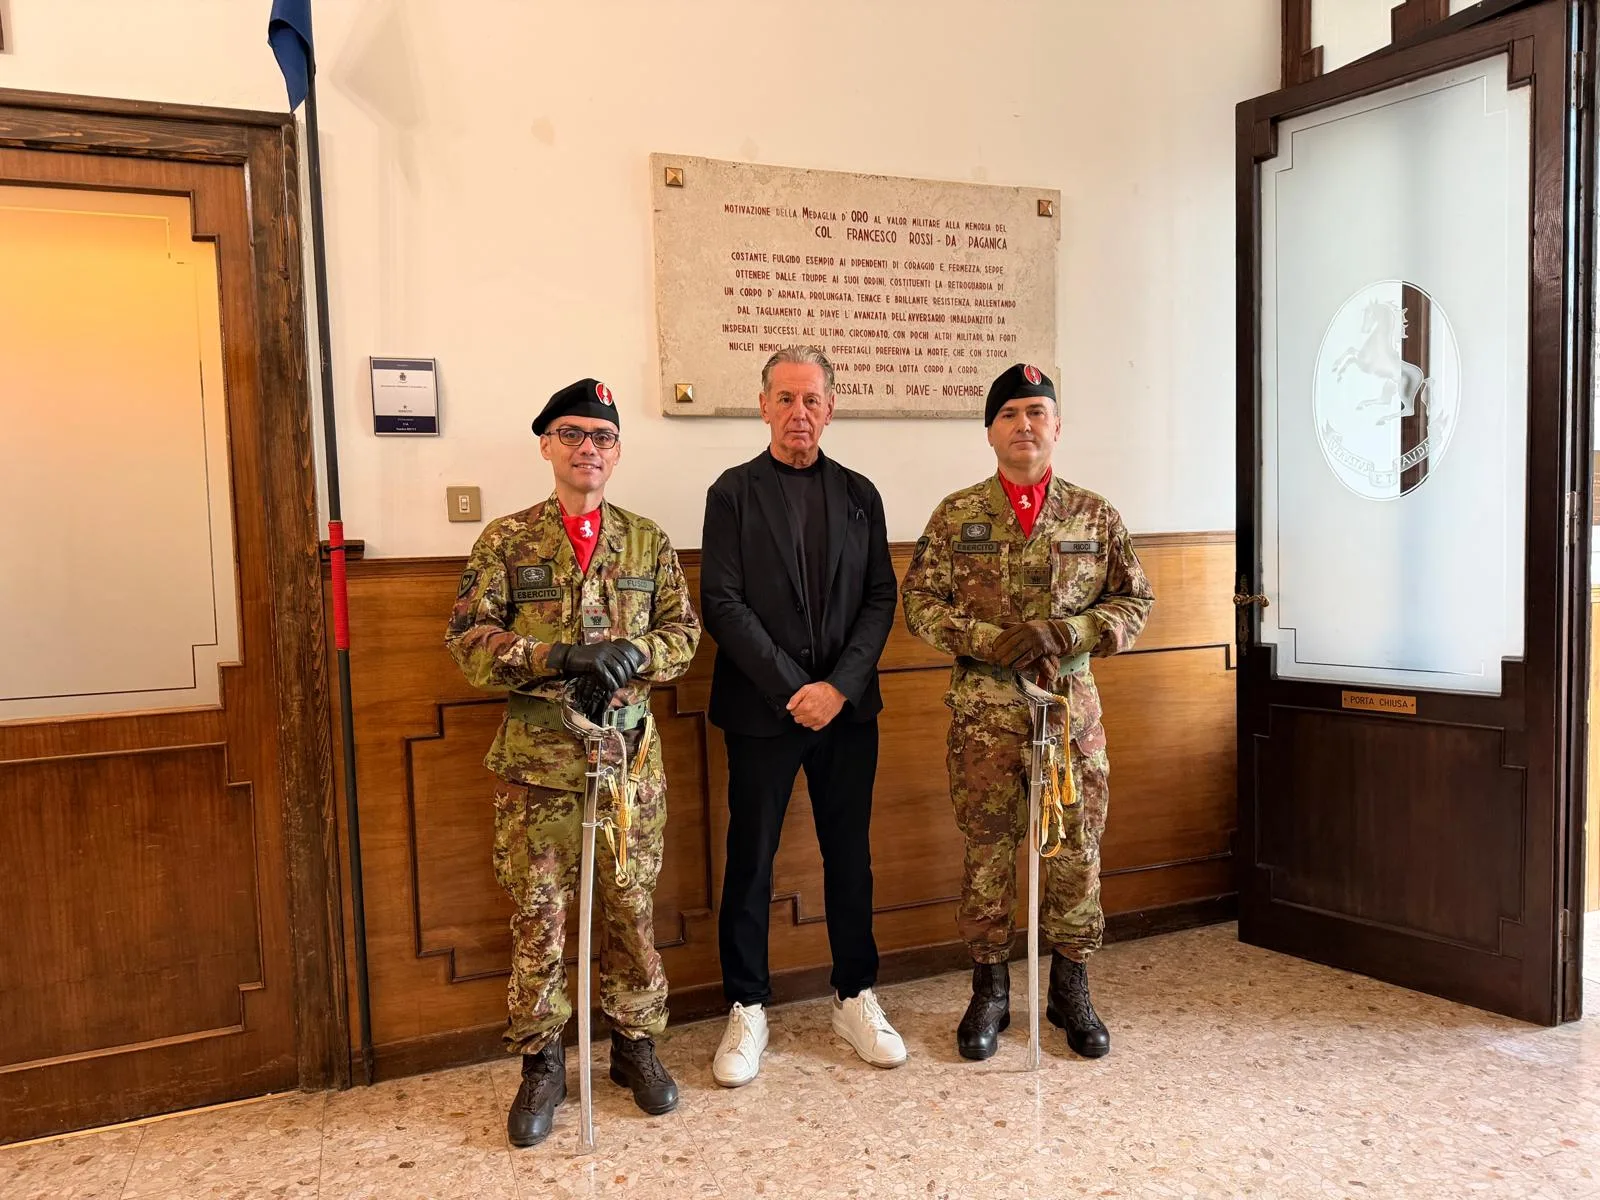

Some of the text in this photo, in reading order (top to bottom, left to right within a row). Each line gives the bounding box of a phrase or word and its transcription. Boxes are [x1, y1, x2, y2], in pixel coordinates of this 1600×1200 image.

[724, 204, 770, 216] MOTIVAZIONE
[776, 208, 797, 218] DELLA
[851, 210, 868, 223] ORO
[874, 215, 881, 224] AL
[887, 216, 907, 226] VALOR
[912, 218, 940, 229] MILITARE
[945, 220, 960, 230] ALLA
[965, 222, 991, 232] MEMORIA
[995, 223, 1007, 233] DEL
[847, 227, 897, 243] FRANCESCO
[909, 231, 933, 246] ROSSI
[945, 234, 957, 248] DA
[968, 235, 1008, 251] PAGANICA
[772, 253, 801, 264] FULGIDO
[805, 255, 835, 267] ESEMPIO
[839, 258, 846, 266] AI
[851, 258, 888, 269] DIPENDENTI
[892, 260, 899, 269] DI
[904, 261, 935, 271] CORAGGIO
[984, 265, 1004, 275] SEPPE
[735, 269, 771, 280] OTTENERE
[775, 271, 797, 282] DALLE
[802, 273, 827, 284] TRUPPE
[832, 275, 839, 284] AI
[843, 276, 859, 285] SUOI
[889, 278, 931, 288] COSTITUENTI
[935, 280, 943, 289] LA
[947, 281, 993, 291] RETROGUARDIA
[997, 283, 1004, 291] DI
[724, 286, 734, 296] UN
[739, 287, 762, 297] CORPO
[857, 293, 881, 303] TENACE
[885, 295, 890, 304] E
[894, 295, 928, 305] BRILLANTE
[974, 299, 1017, 309] RALLENTANDO
[737, 305, 751, 315] DAL
[756, 306, 802, 317] TAGLIAMENTO
[807, 308, 815, 318] AL
[820, 309, 840, 319] PIAVE
[853, 311, 887, 321] AVANZATA
[950, 314, 993, 325] IMBALDANZITO
[997, 315, 1006, 325] DA
[722, 323, 758, 335] INSPERATI
[892, 330, 906, 339] CON
[910, 330, 929, 340] POCHI
[934, 331, 952, 341] ALTRI
[986, 334, 995, 342] DA
[999, 334, 1017, 343] FORTI
[728, 342, 754, 352] NUCLEI
[831, 345, 871, 355] OFFERTAGLI
[875, 346, 911, 356] PREFERIVA
[914, 347, 923, 357] LA
[952, 348, 965, 358] CHE
[969, 349, 982, 358] CON
[986, 349, 1008, 359] STOICA
[831, 362, 850, 372] TAVA
[853, 363, 871, 372] DOPO
[875, 363, 895, 373] EPICA
[899, 364, 919, 374] LOTTA
[923, 365, 944, 374] CORPO
[948, 366, 953, 375] A
[885, 384, 895, 396] DI
[905, 384, 930, 397] PIAVE
[942, 384, 984, 398] NOVEMBRE
[957, 543, 994, 551] ESERCITO
[517, 589, 557, 600] ESERCITO
[1350, 696, 1408, 708] PORTA CHIUSA
